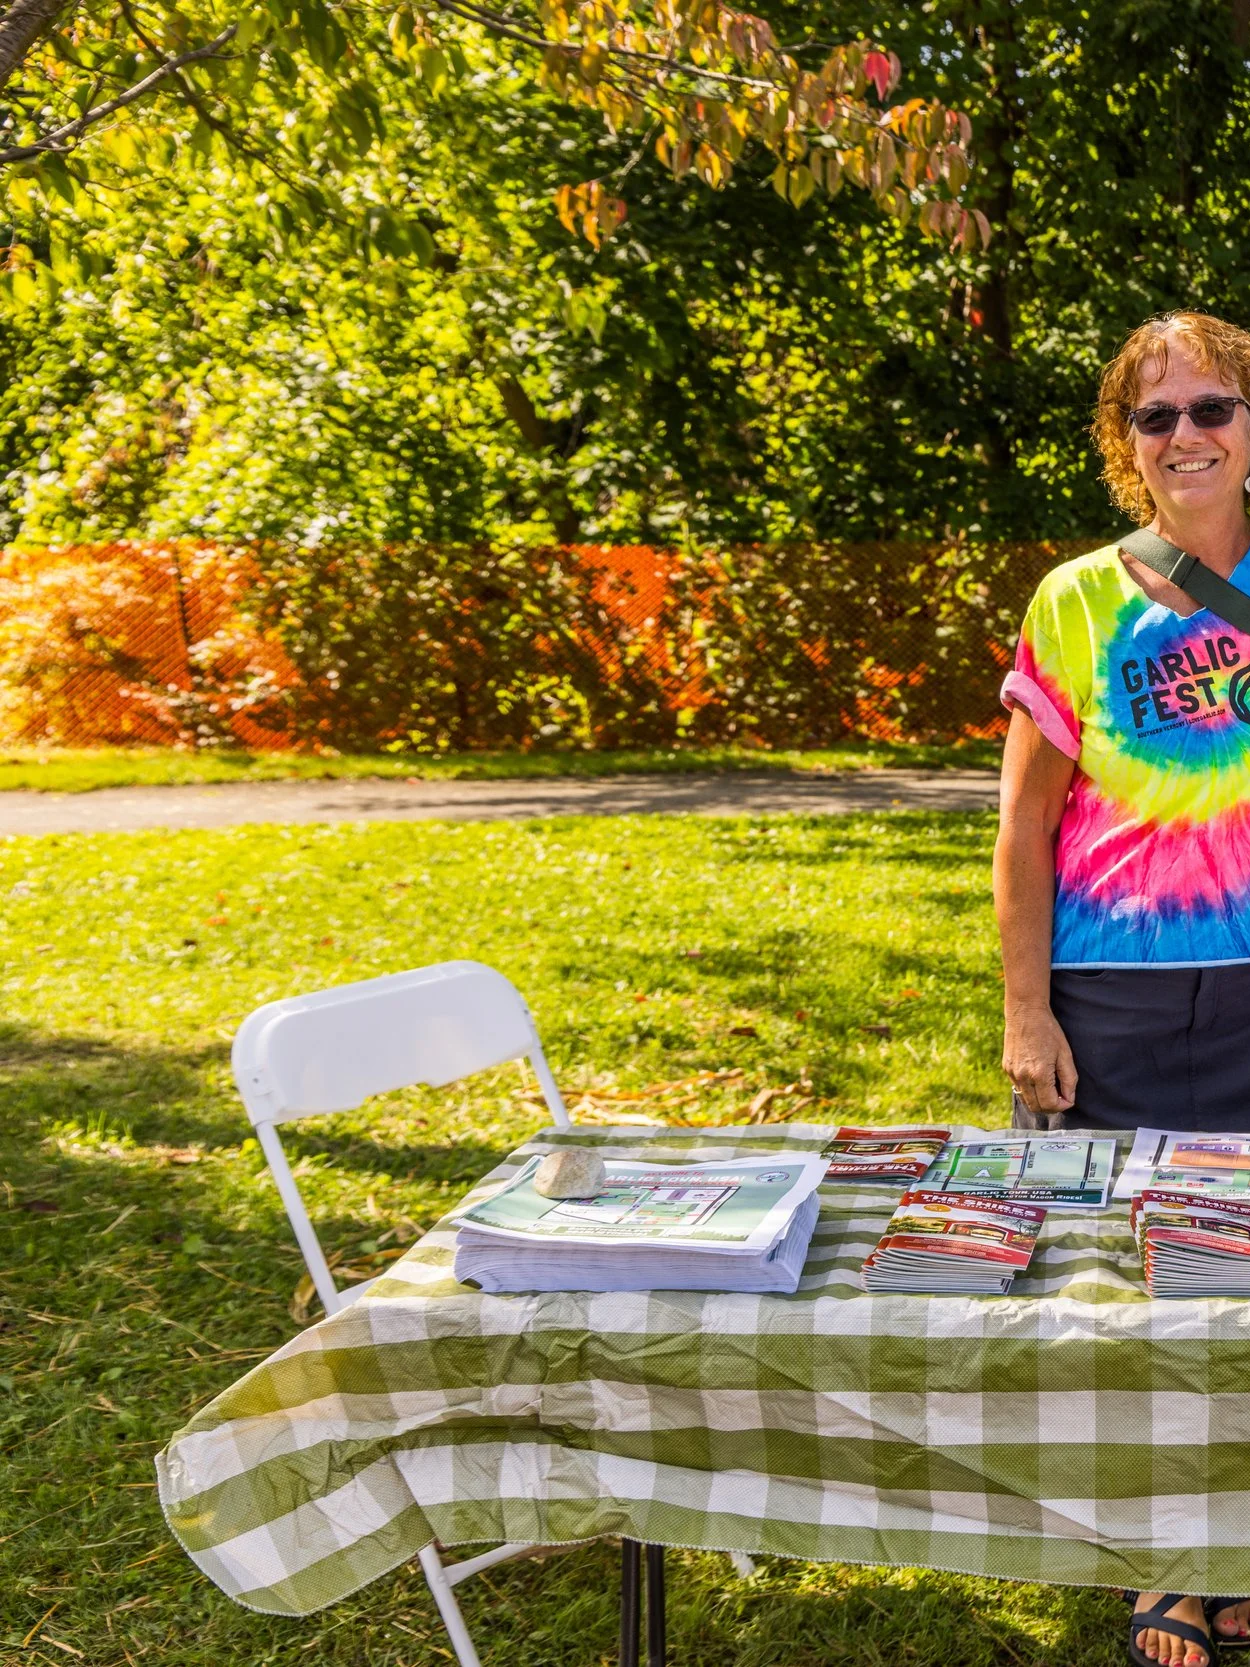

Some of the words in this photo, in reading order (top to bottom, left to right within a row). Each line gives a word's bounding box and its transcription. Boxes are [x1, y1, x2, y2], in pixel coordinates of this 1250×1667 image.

[1121, 636, 1241, 694] GARLIC
[1130, 677, 1218, 729] FEST
[920, 1194, 960, 1204] THE
[963, 1199, 1037, 1217] SHIRES
